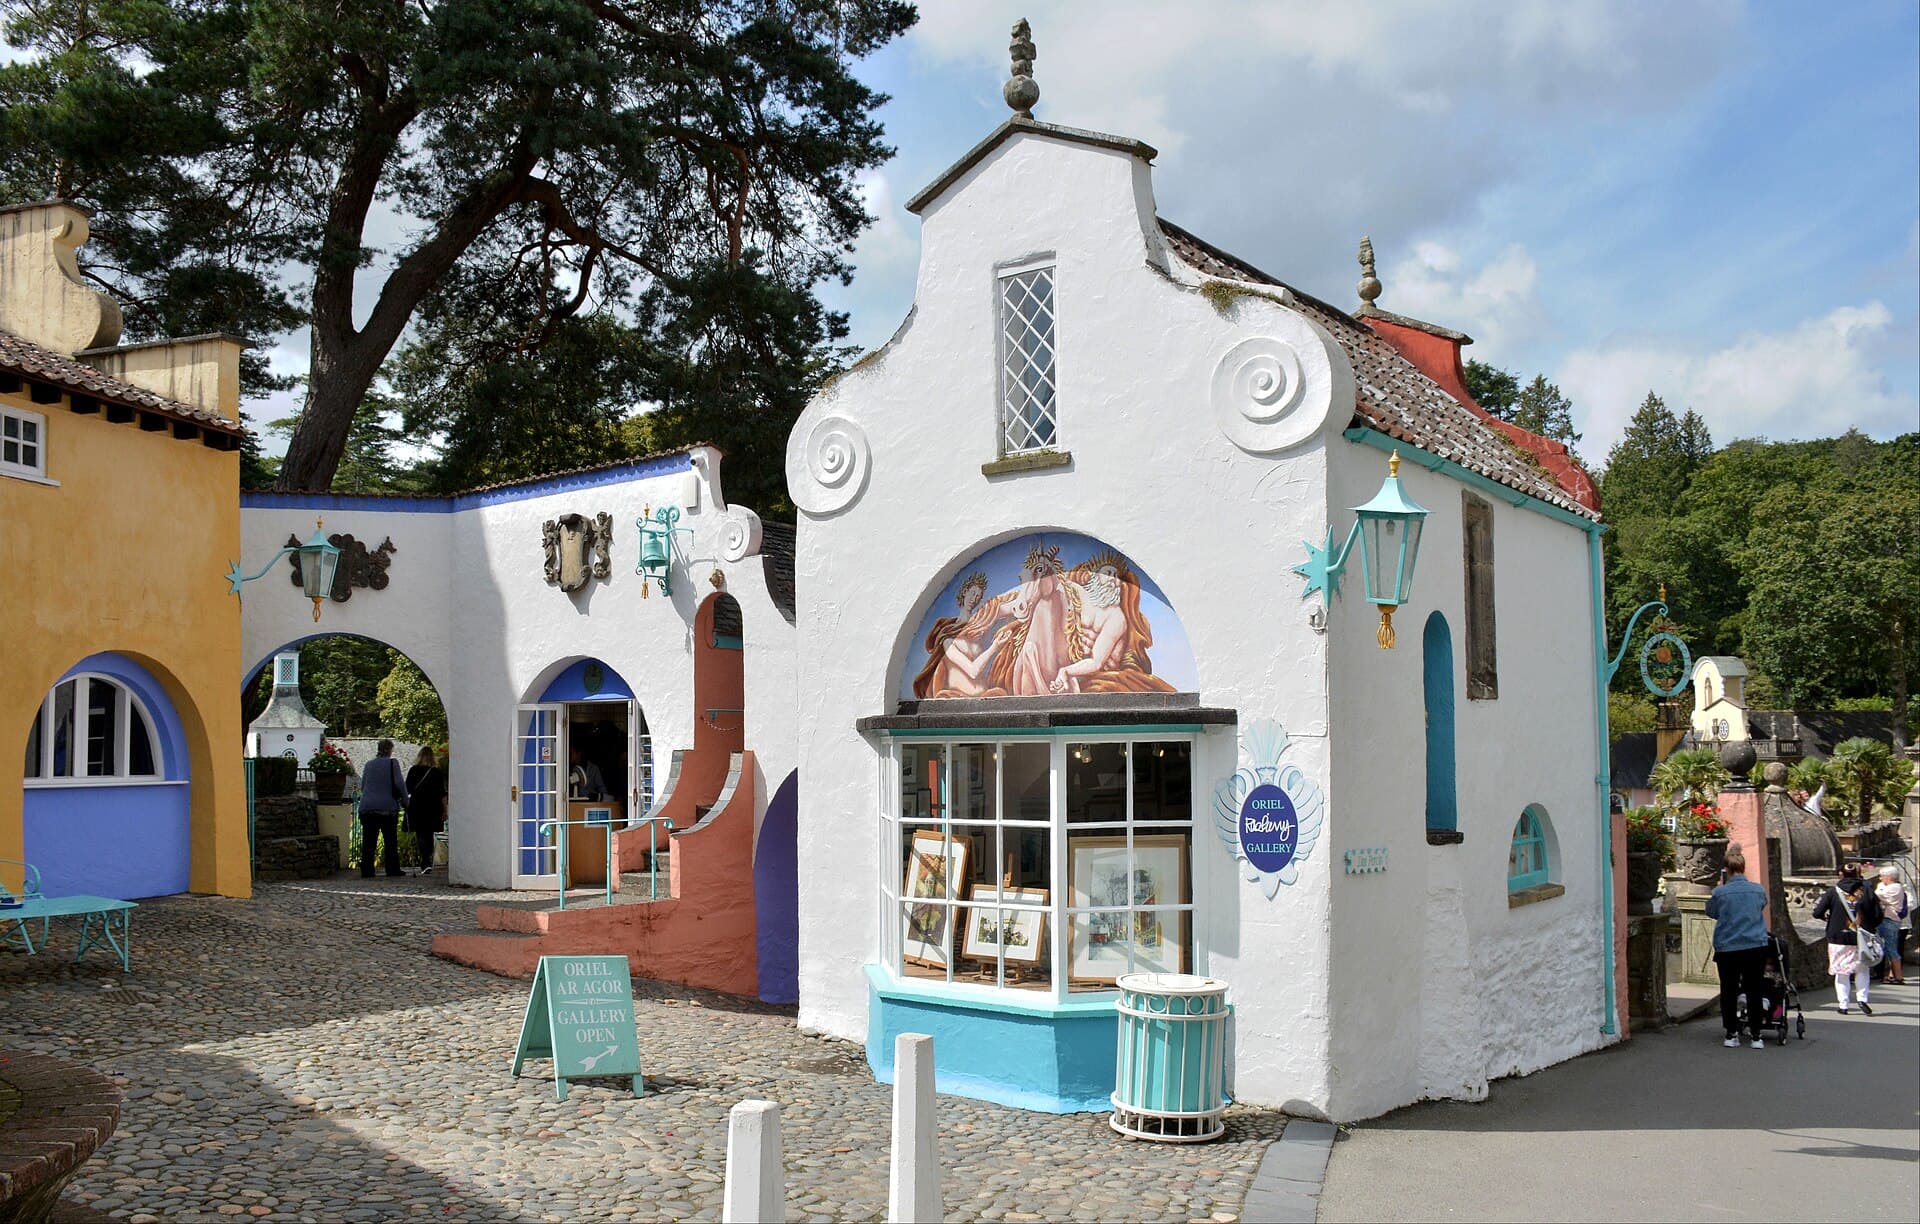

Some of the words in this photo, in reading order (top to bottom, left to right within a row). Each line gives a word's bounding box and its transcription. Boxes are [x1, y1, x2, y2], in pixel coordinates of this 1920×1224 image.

[1251, 799, 1285, 810] ORIEL
[1246, 843, 1293, 853] GALLERY
[564, 962, 612, 977] ORIEL
[557, 981, 578, 995] AR
[582, 980, 624, 994] AGOR
[557, 1008, 627, 1025] GALLERY
[575, 1027, 617, 1043] OPEN
